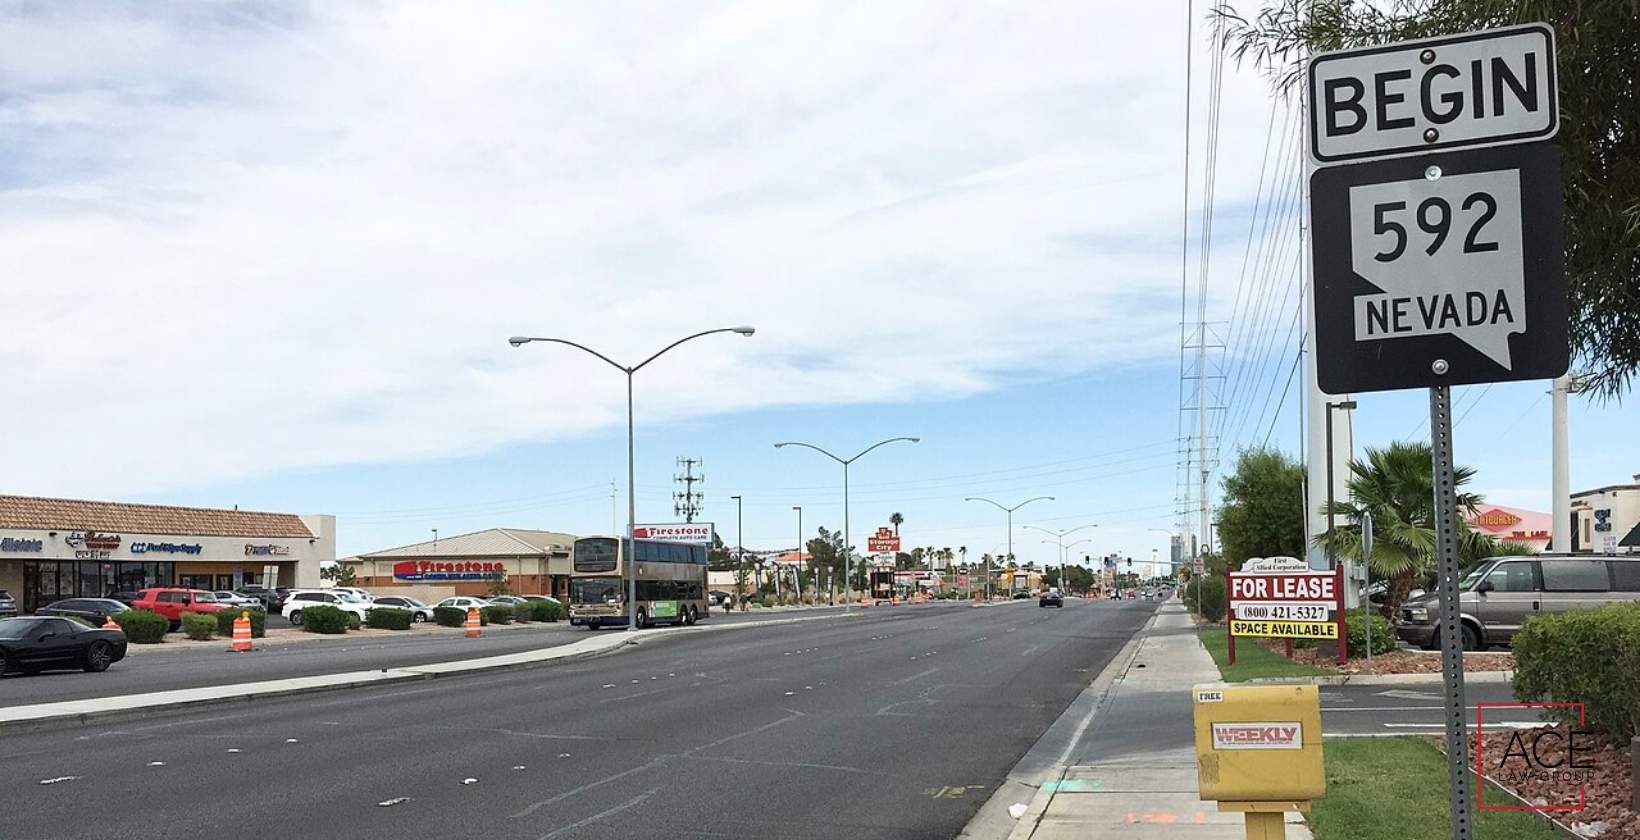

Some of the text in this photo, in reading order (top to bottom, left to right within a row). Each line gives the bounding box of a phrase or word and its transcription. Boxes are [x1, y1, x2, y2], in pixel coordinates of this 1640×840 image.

[1324, 53, 1538, 138] BEGIN
[1373, 191, 1499, 263] 592
[1366, 289, 1514, 334] NEVADA
[649, 527, 708, 536] Firestone
[418, 560, 503, 572] Firestone
[1232, 577, 1334, 599] FOR LEASE
[1243, 605, 1325, 619] (800) 421-5327
[1234, 622, 1334, 636] SPACE AVAILABLE
[1199, 692, 1221, 700] FREE
[1215, 727, 1297, 742] WEEKLY
